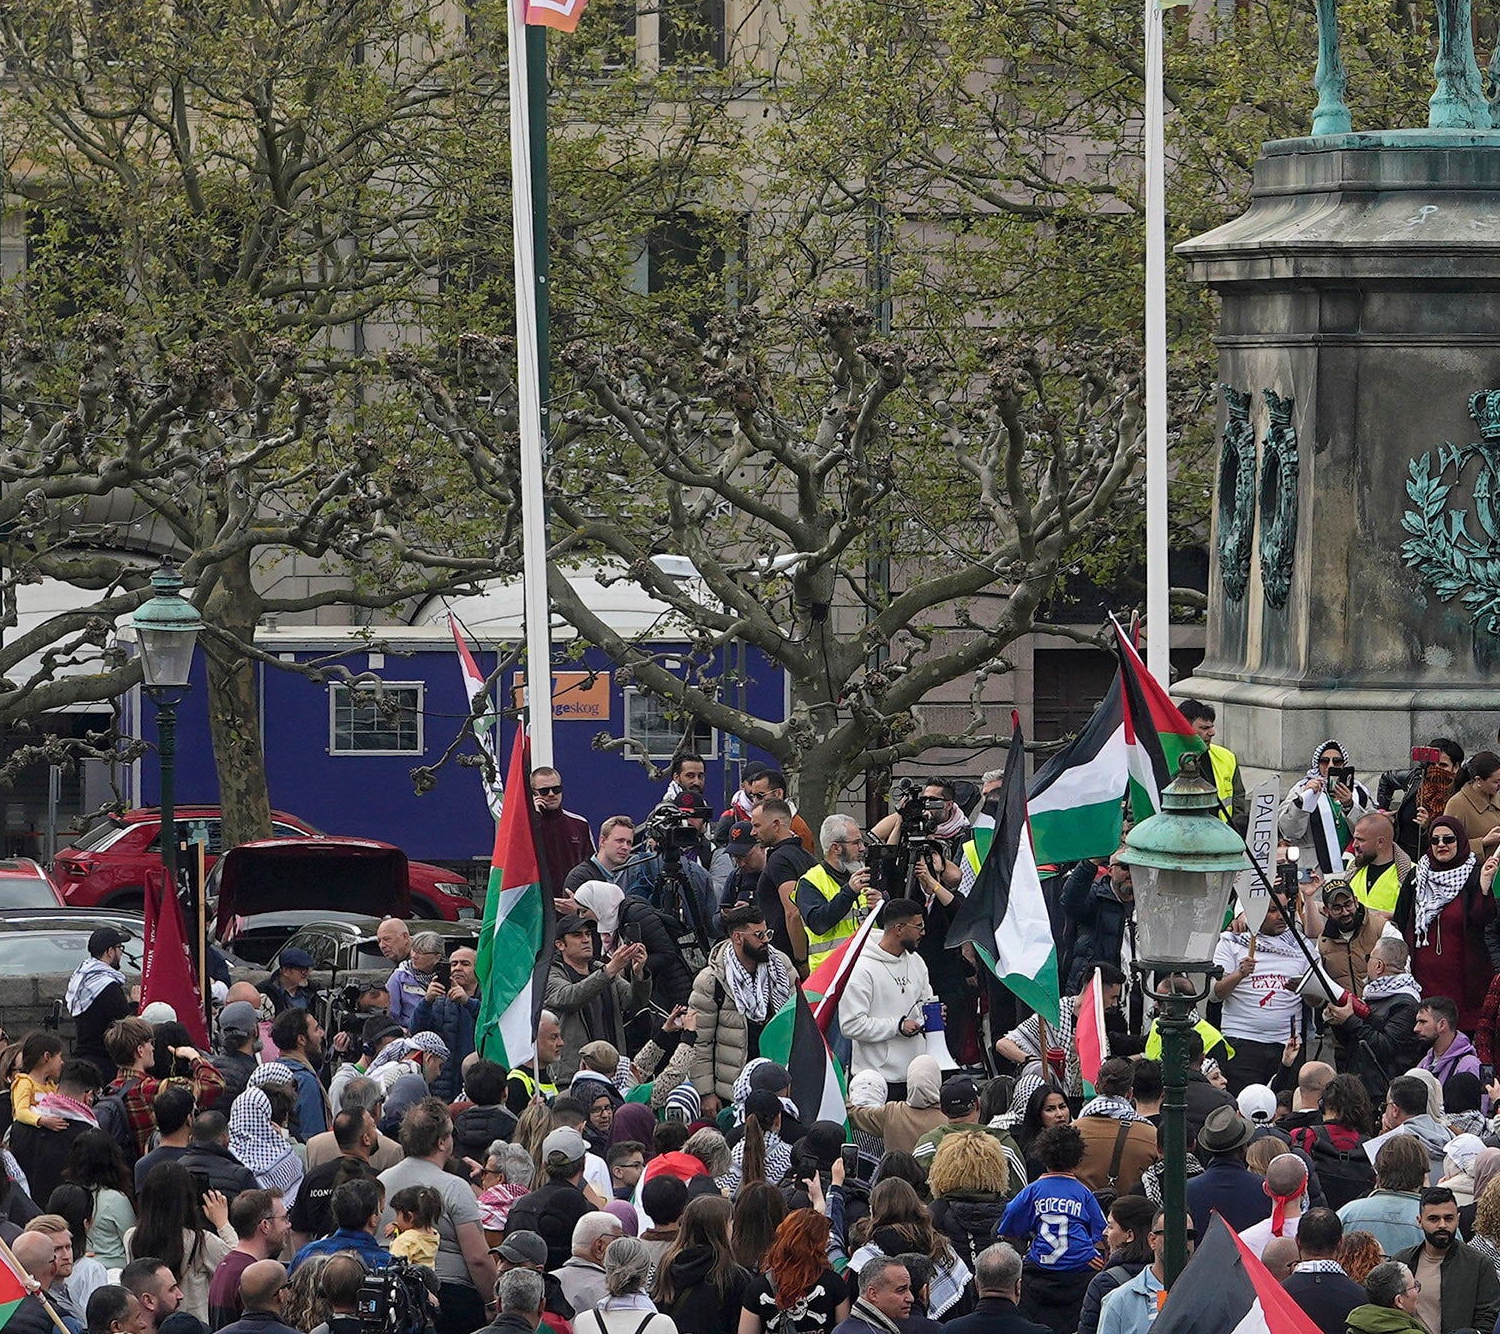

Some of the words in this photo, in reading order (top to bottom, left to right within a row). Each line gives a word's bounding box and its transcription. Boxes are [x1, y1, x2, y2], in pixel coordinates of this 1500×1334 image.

[1249, 793, 1274, 898] PALESTINE
[1033, 1196, 1083, 1218] BENZEMA
[1038, 1212, 1070, 1265] 9
